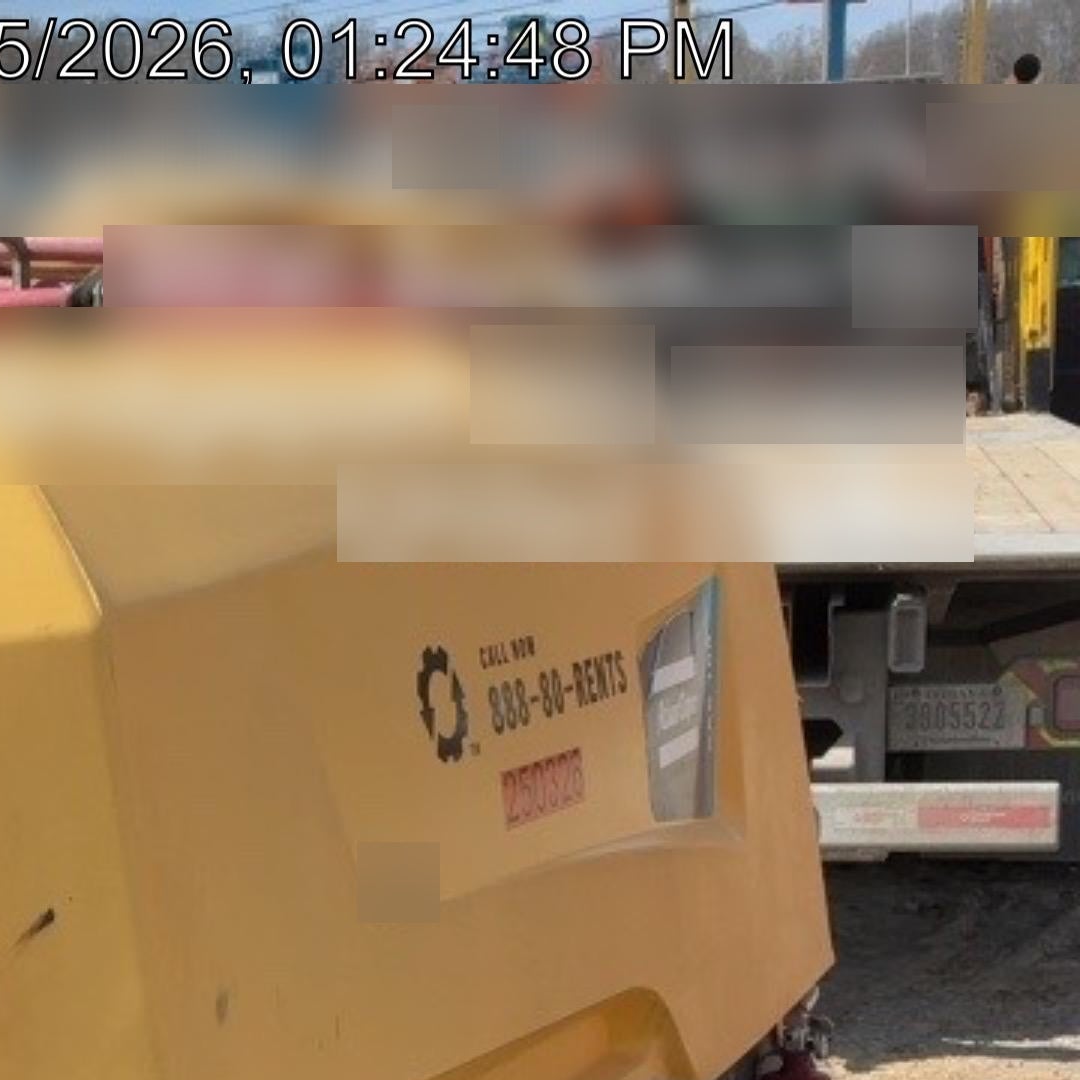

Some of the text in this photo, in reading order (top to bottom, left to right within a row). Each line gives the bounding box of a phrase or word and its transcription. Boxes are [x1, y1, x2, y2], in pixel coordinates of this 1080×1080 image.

[479, 635, 535, 669] CALL NOW
[488, 650, 628, 735] 888-80-RENTS
